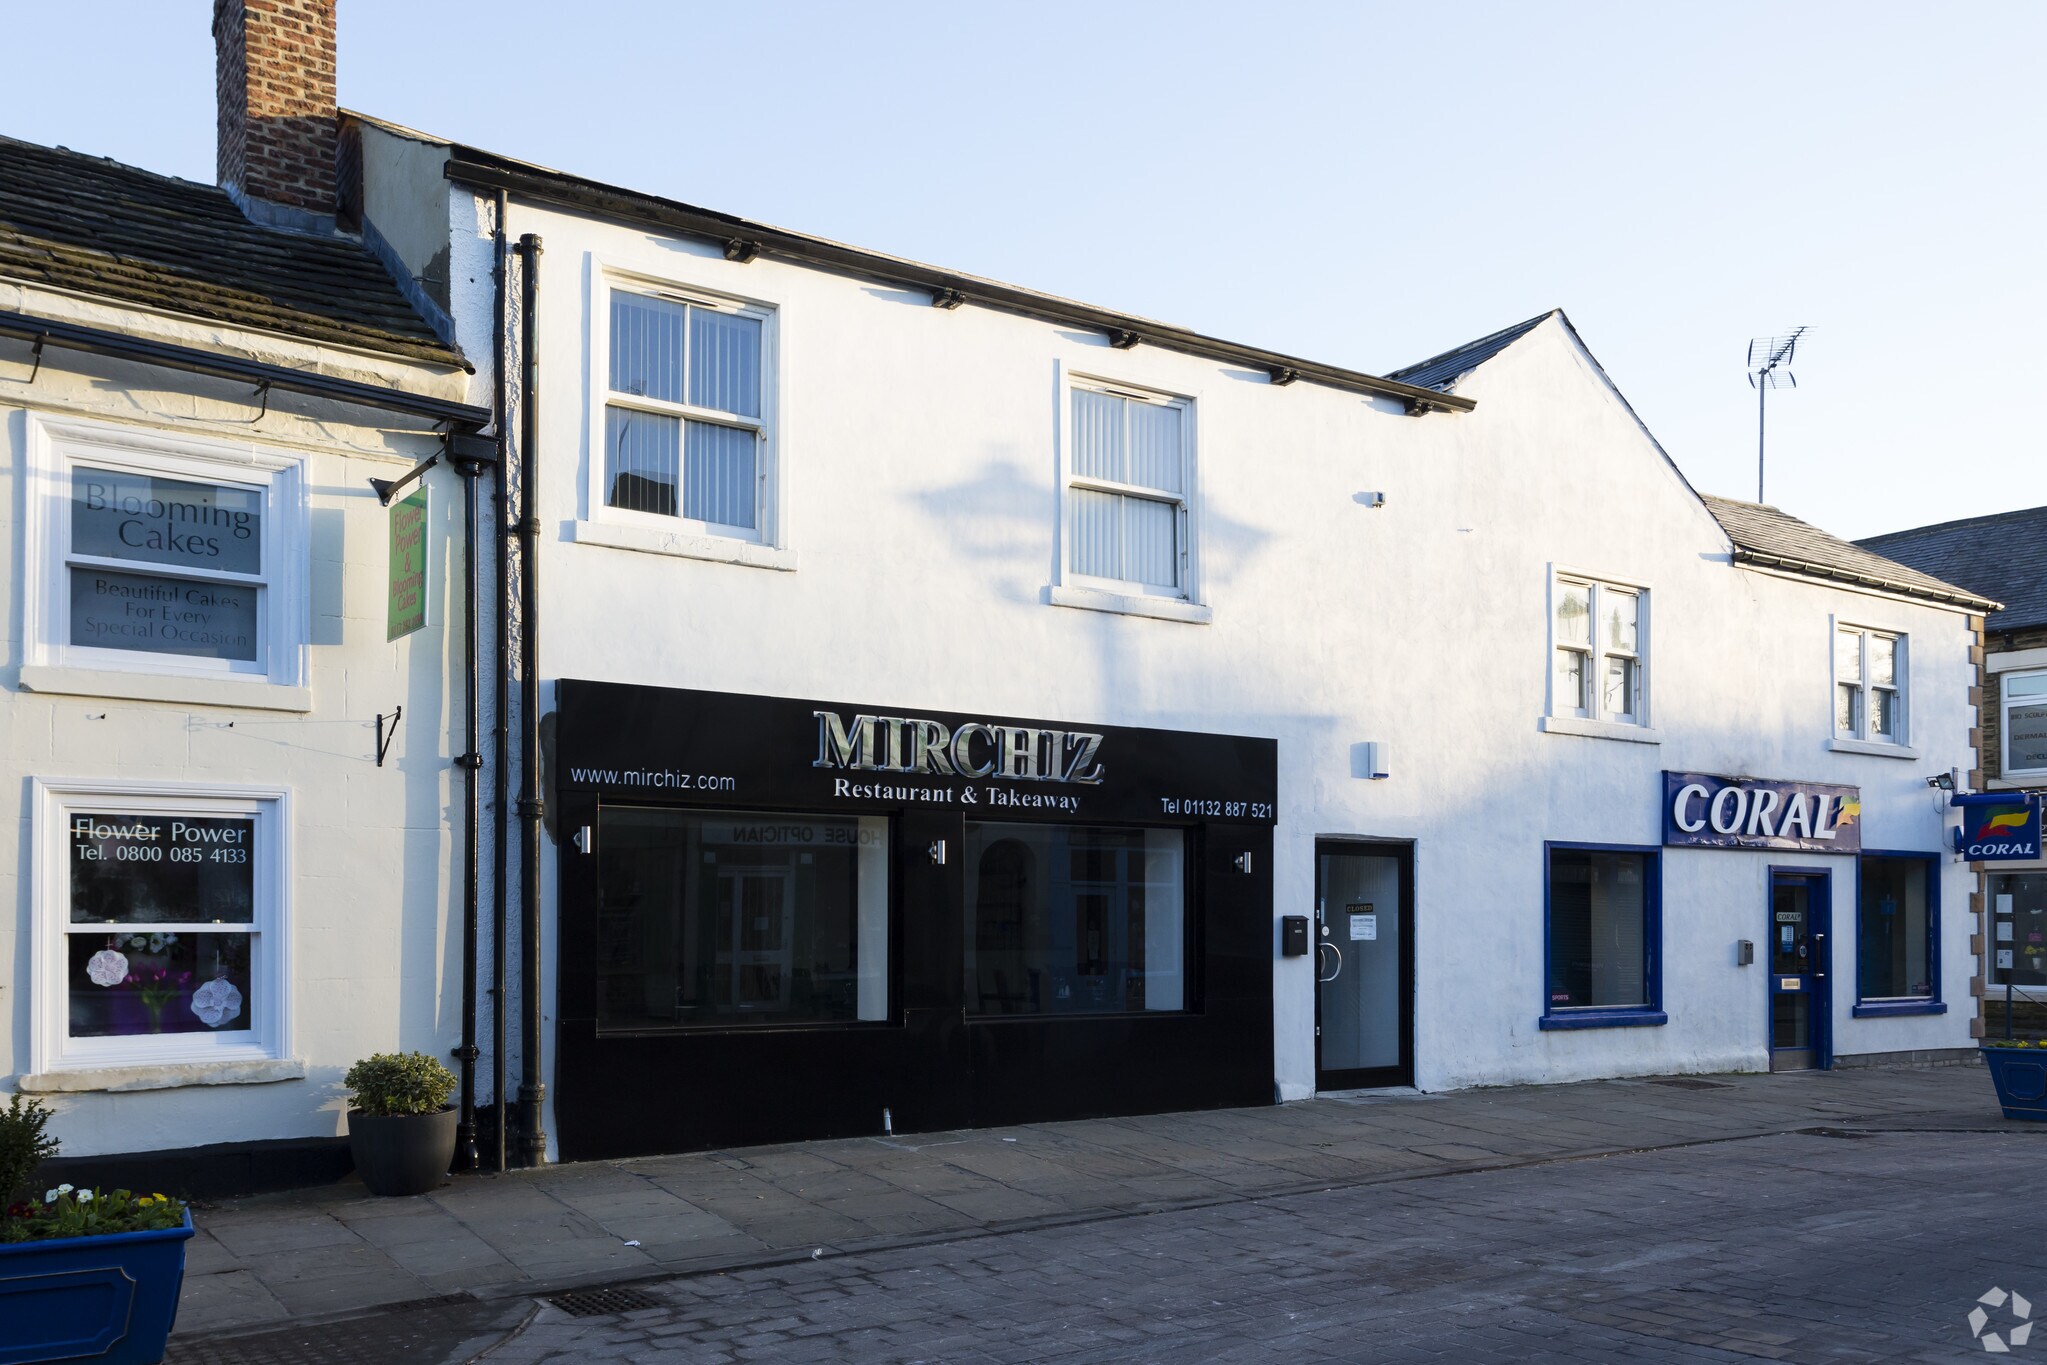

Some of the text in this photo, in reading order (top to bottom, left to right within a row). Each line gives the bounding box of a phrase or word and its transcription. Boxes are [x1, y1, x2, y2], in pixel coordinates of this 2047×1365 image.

[86, 483, 251, 539] Blooming
[394, 504, 423, 535] Flower
[118, 519, 220, 557] Cakes
[395, 527, 422, 556] Power
[404, 554, 412, 573] &
[95, 579, 240, 608] Beautiful Cakes
[392, 571, 424, 597] Blooming
[125, 602, 211, 627] For Every
[398, 592, 417, 612] Cakes
[85, 617, 248, 647] Special Occasion
[812, 710, 1105, 785] MIRCHIZ
[571, 768, 735, 791] www.mirchiz.com
[834, 777, 1081, 813] Restaurant & Takeaway
[1161, 798, 1273, 818] Tel 01132 887 521
[1674, 784, 1836, 839] CORAL
[75, 818, 247, 844] Flower Power
[77, 844, 247, 864] Tel. 0800 085 4133
[1968, 843, 2034, 856] CORAL
